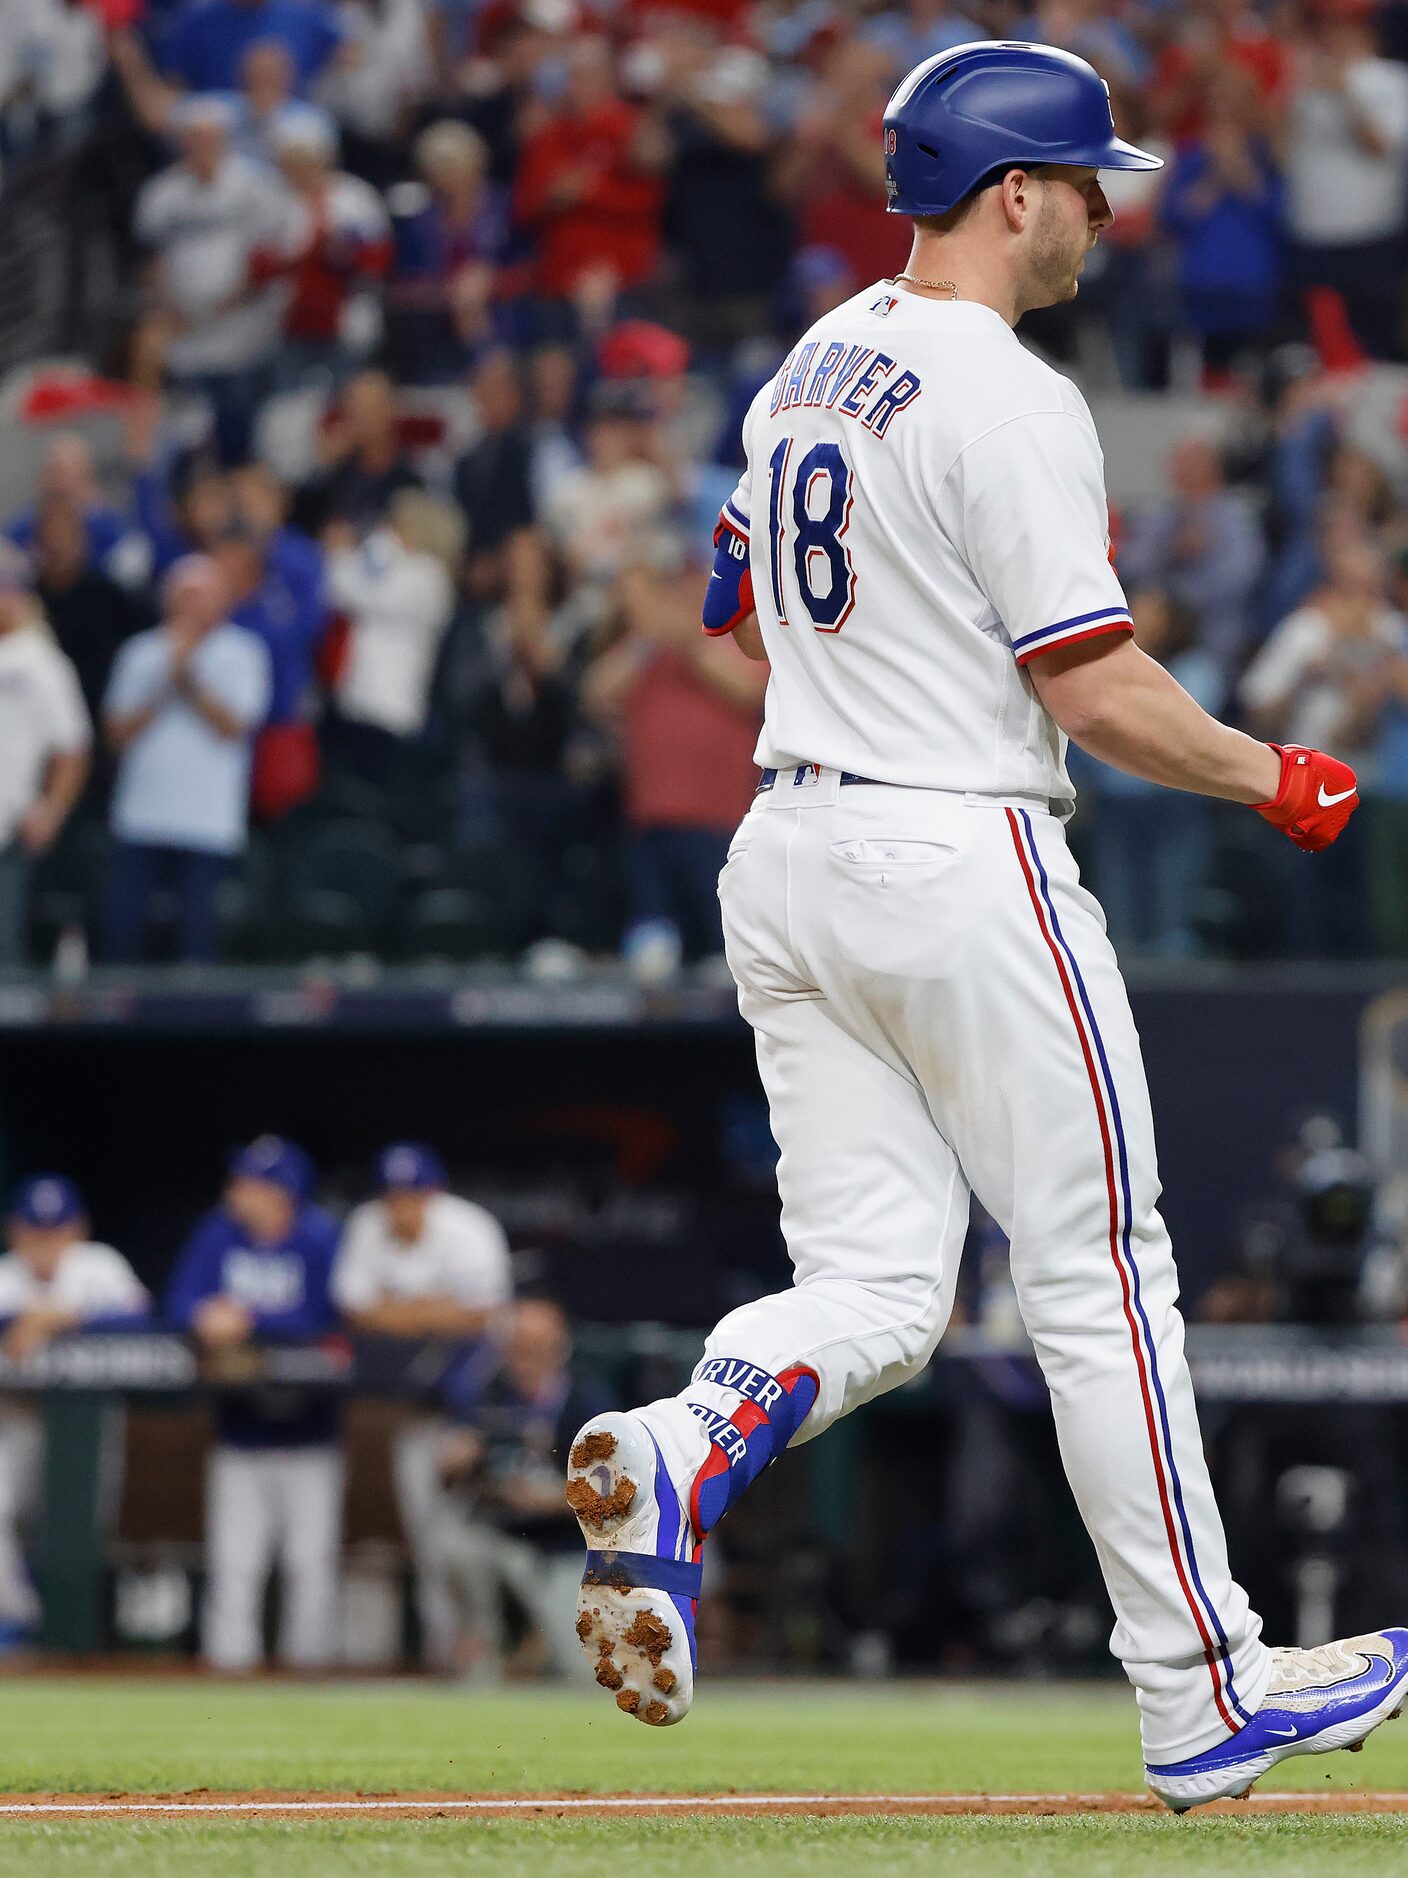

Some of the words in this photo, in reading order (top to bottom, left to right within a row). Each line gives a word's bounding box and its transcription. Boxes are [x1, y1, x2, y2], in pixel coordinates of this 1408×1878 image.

[770, 340, 922, 440] GARVER
[768, 434, 858, 634] 18
[698, 1360, 783, 1413] RVER
